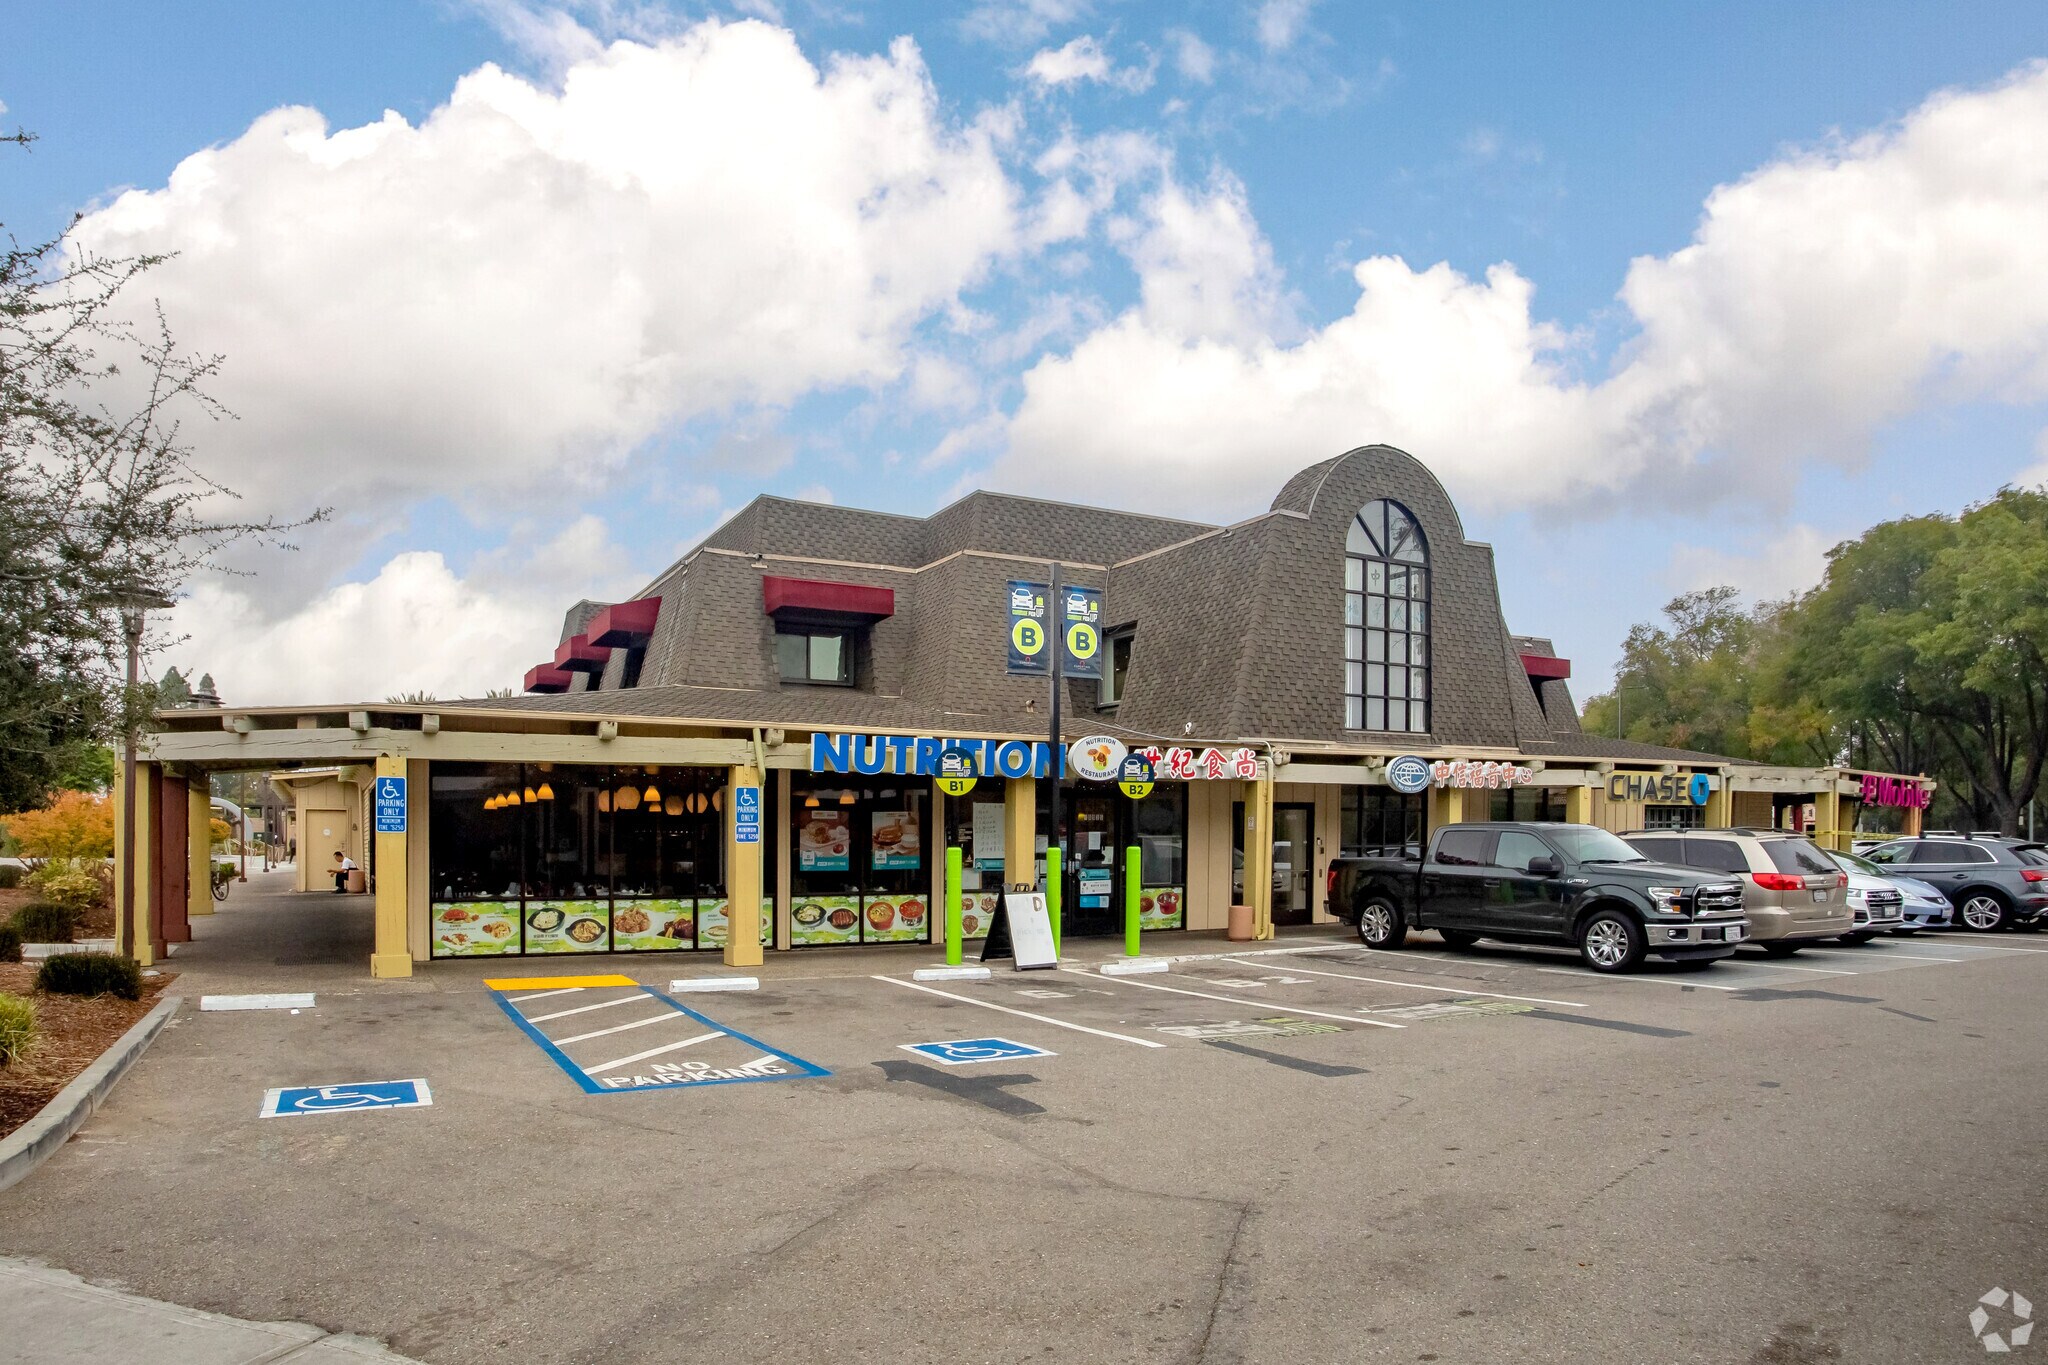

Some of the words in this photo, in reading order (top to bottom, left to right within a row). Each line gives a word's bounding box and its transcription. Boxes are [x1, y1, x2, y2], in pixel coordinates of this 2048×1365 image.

[1021, 627, 1037, 647] B
[1075, 631, 1091, 651] B
[1085, 738, 1117, 747] NUTRITION
[811, 733, 1067, 780] NUTRION
[1080, 767, 1118, 778] RESTAURANT
[1435, 761, 1533, 788] 中信福音中心
[949, 780, 964, 791] B1
[1129, 784, 1144, 795] B2
[1610, 775, 1688, 801] CHASE
[378, 799, 405, 808] PARKING
[383, 807, 400, 816] ONLY
[737, 805, 758, 814] PARKING
[741, 814, 754, 822] ONLY
[649, 1061, 711, 1074] NO
[602, 1065, 788, 1088] PARKING
